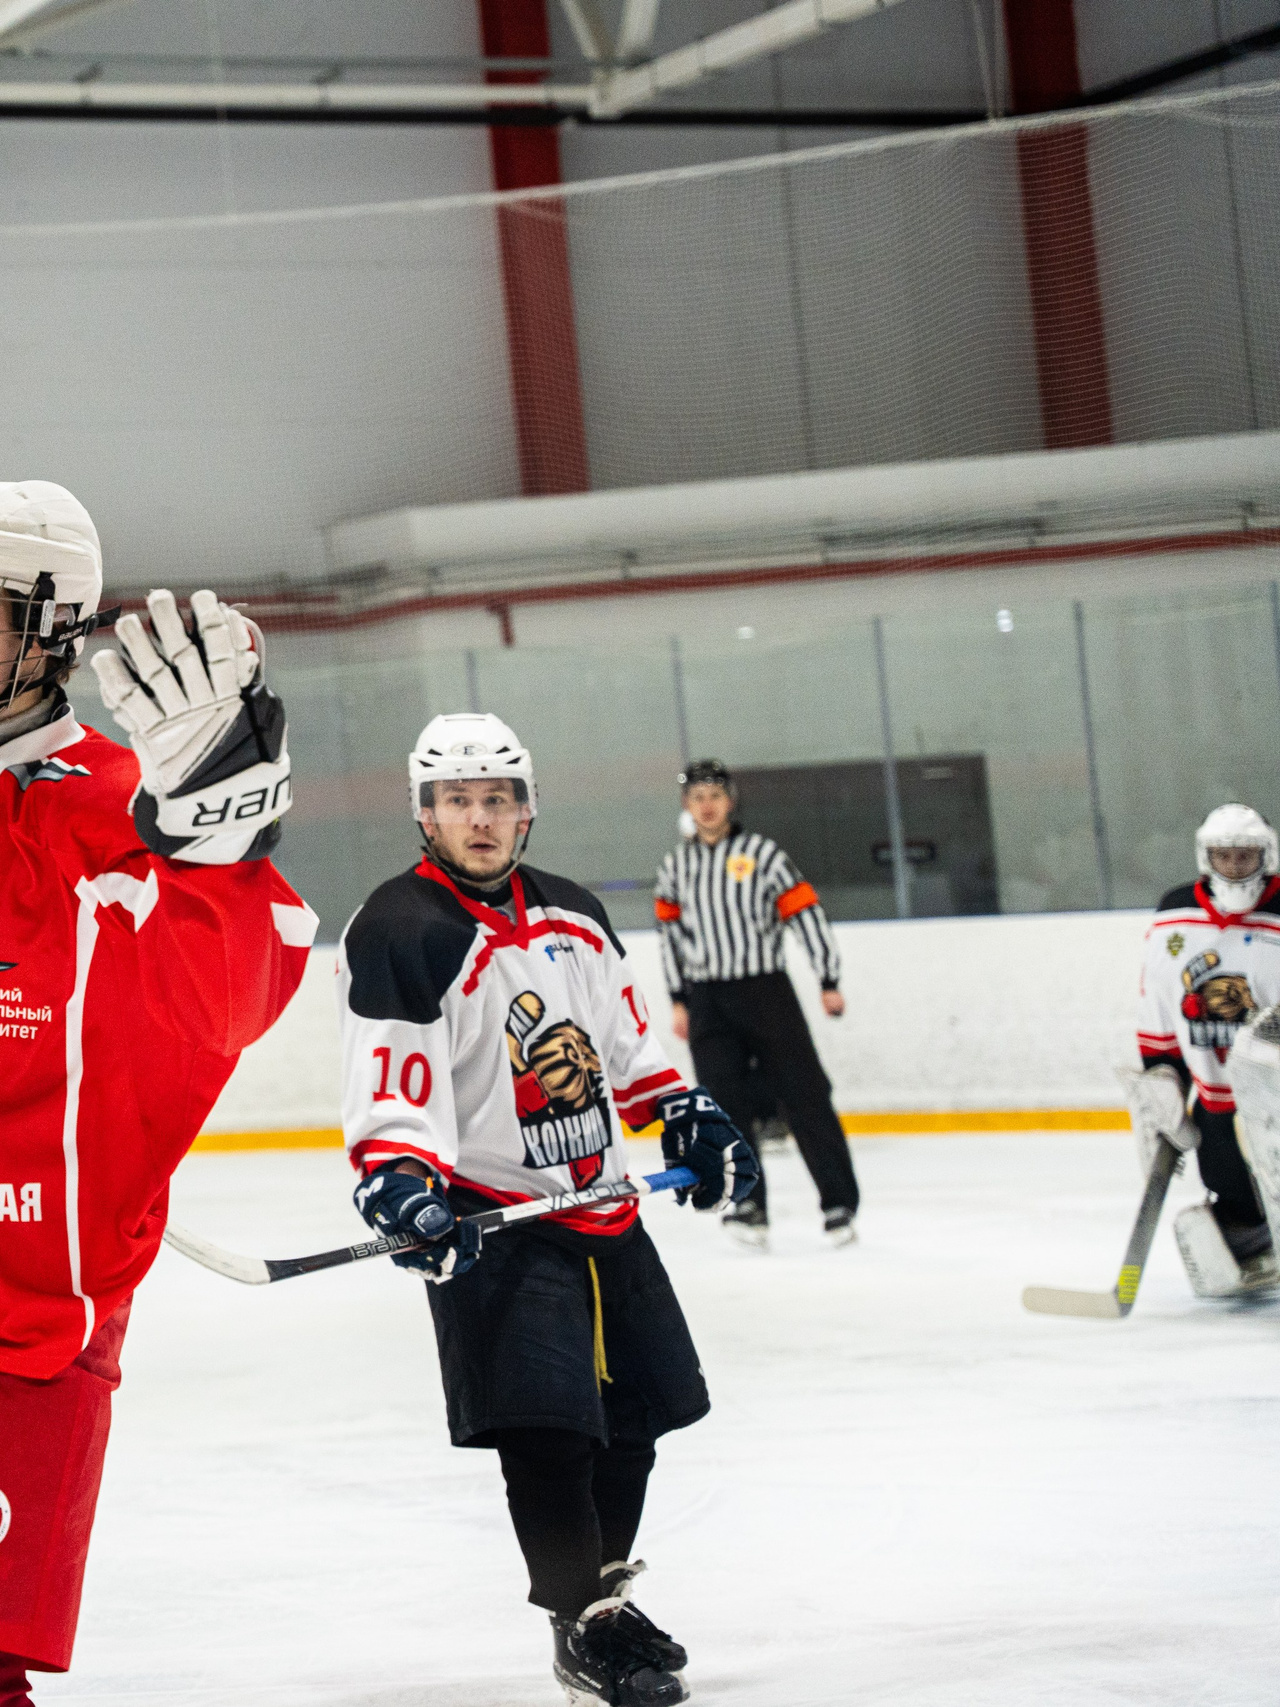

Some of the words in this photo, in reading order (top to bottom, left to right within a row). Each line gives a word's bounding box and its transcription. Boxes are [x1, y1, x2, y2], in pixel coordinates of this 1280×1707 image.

[621, 984, 650, 1038] 1
[372, 1046, 433, 1108] 10
[663, 1095, 722, 1122] CC
